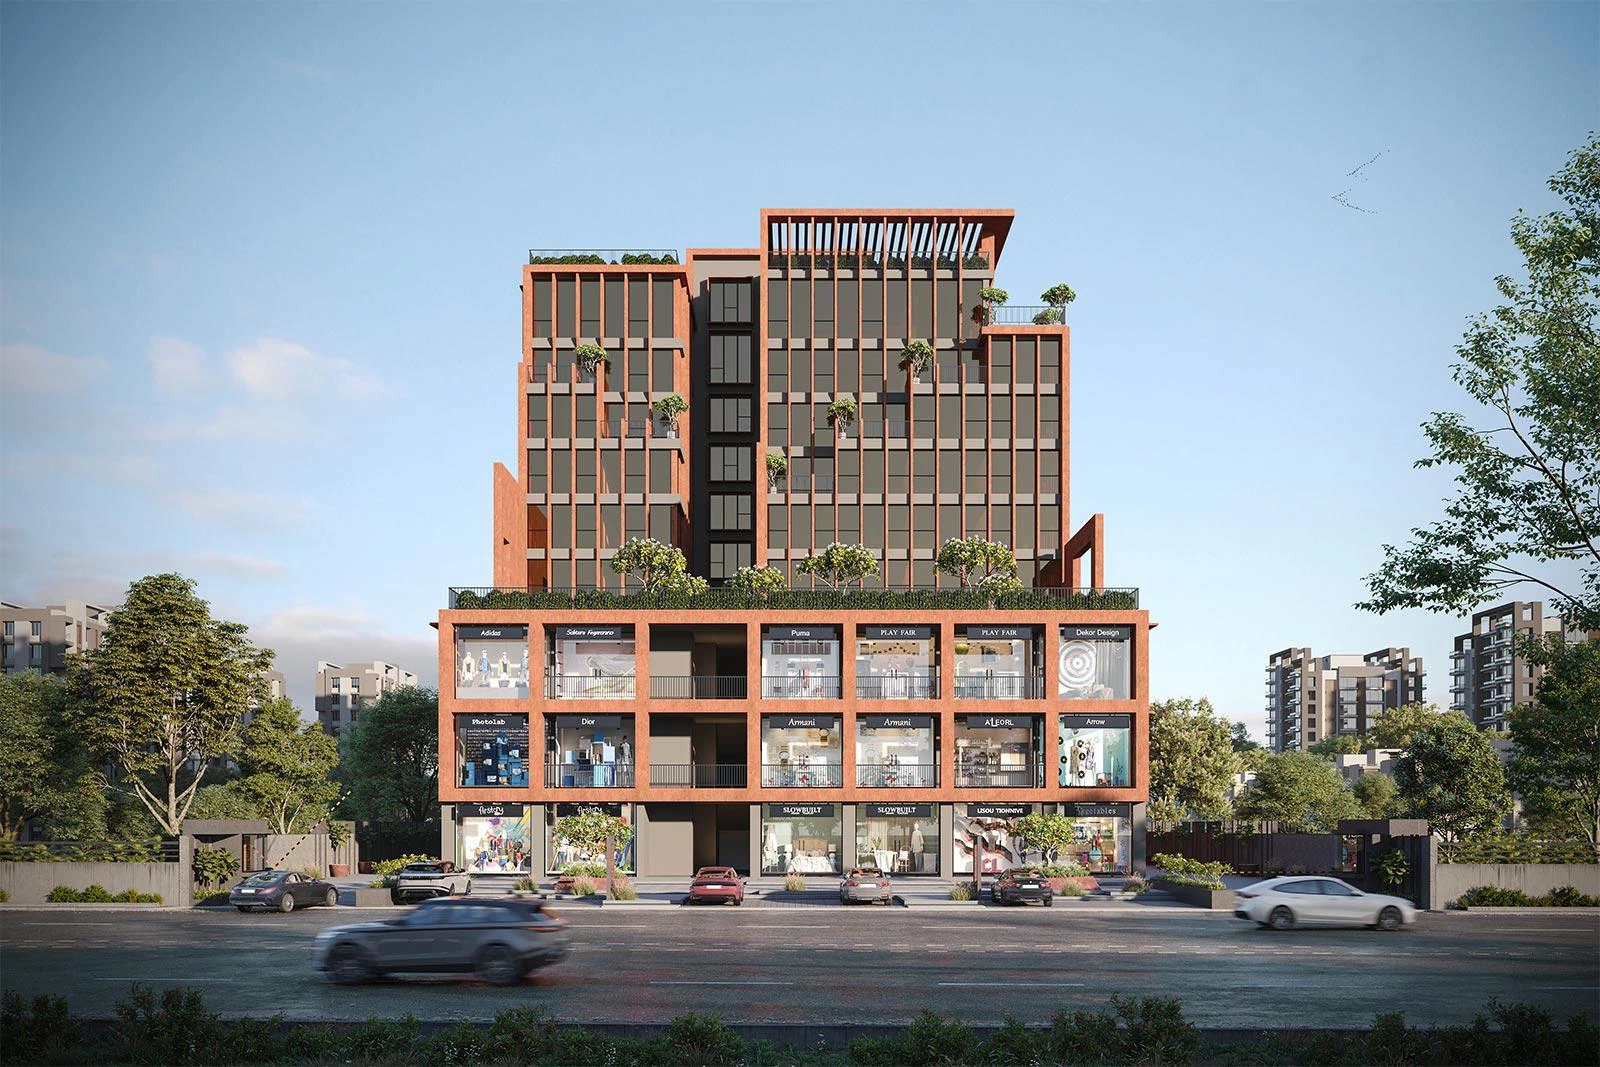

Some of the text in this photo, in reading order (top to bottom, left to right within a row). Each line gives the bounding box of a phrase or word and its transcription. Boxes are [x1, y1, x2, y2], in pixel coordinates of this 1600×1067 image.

[1097, 629, 1120, 637] Design
[788, 718, 815, 726] Armani
[884, 718, 911, 726] Armani
[1086, 718, 1105, 726] Arrow
[783, 806, 822, 815] SLOWBUILT
[878, 806, 917, 815] SLOWBUILT
